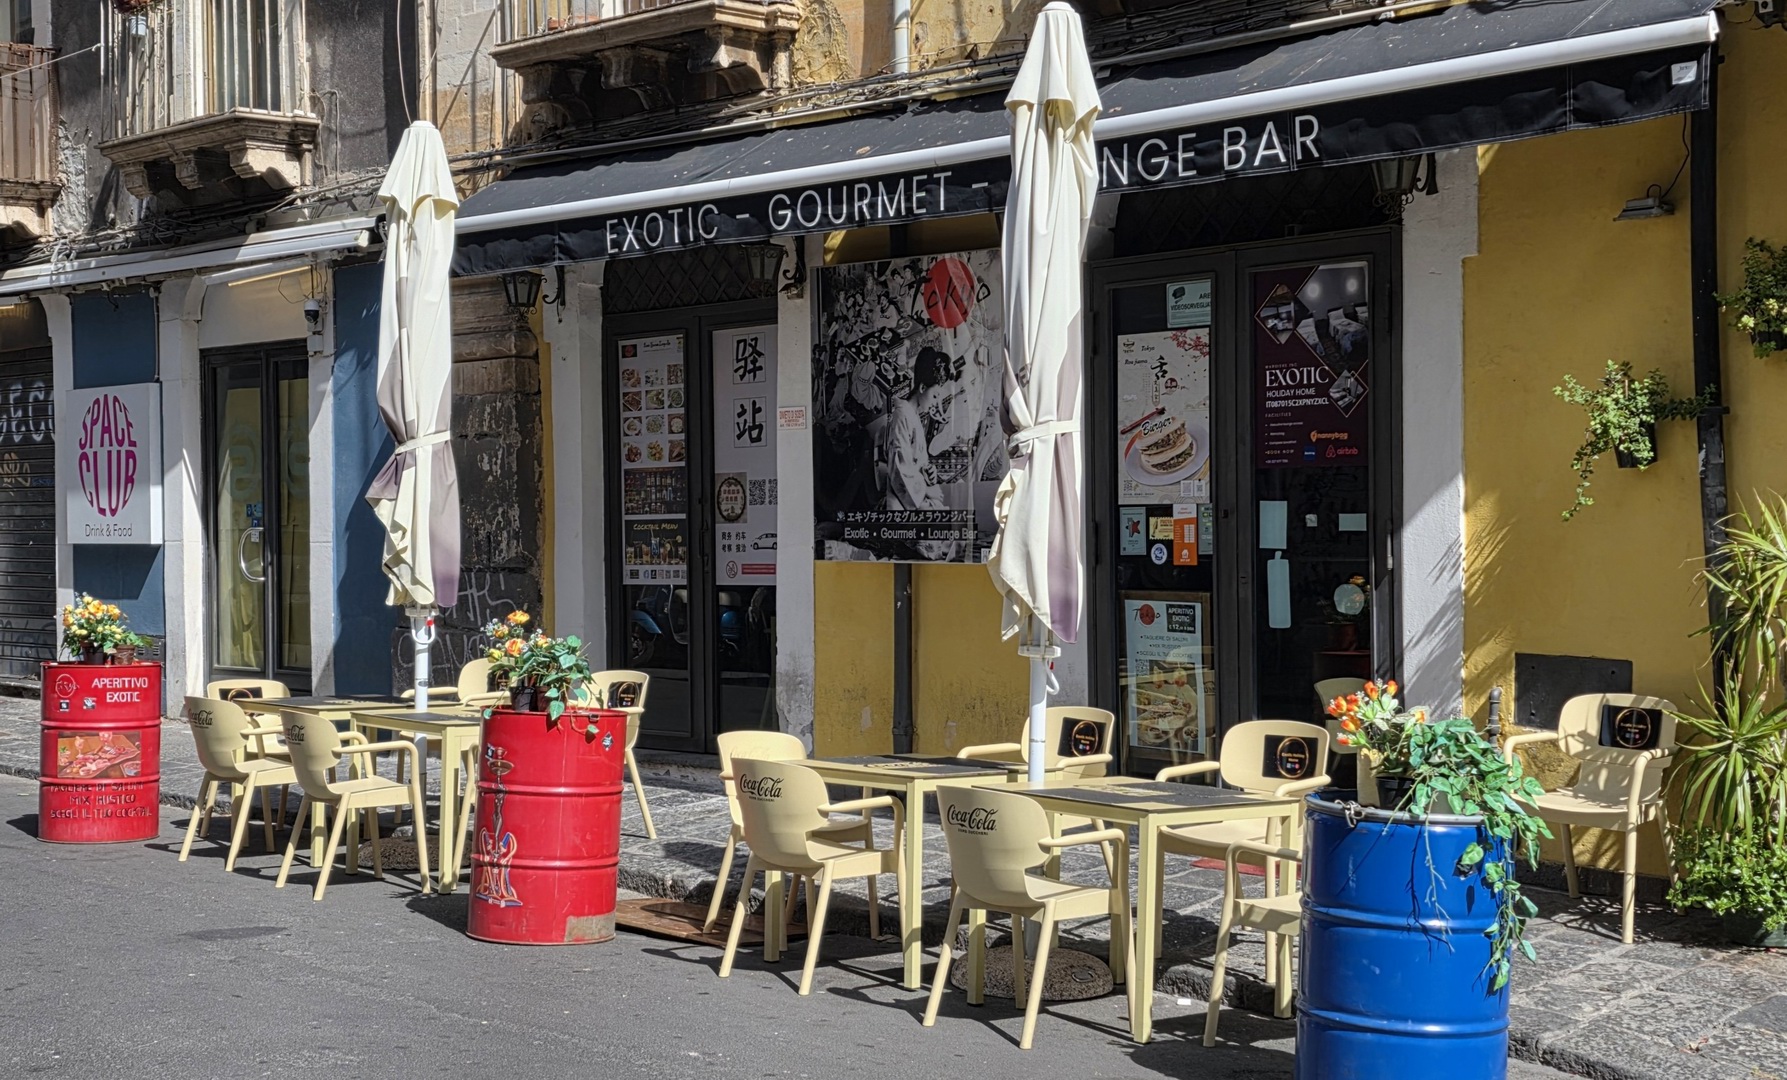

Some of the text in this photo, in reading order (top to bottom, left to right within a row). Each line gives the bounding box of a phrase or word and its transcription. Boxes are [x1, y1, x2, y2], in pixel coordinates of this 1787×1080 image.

[606, 204, 719, 254] EXOTIC
[769, 171, 952, 232] GOURMET
[1102, 132, 1197, 188] NGE
[1223, 114, 1320, 171] BAR
[1266, 366, 1330, 388] EXOTIC
[1266, 387, 1316, 398] HOLIDAY HOME
[79, 394, 137, 450] SPACE
[1337, 446, 1359, 455] airbnb
[79, 450, 137, 517] CLUB
[85, 523, 133, 537] Drink & Food
[844, 527, 978, 542] Exotic Gourmet Lounge Bar
[1168, 607, 1194, 615] APERITIVO
[91, 677, 149, 689] APERITIVO
[106, 691, 141, 703] EXOTIC
[740, 774, 784, 798] Coca-Cola
[69, 794, 91, 805] MIX
[947, 804, 999, 831] Coca-Cola
